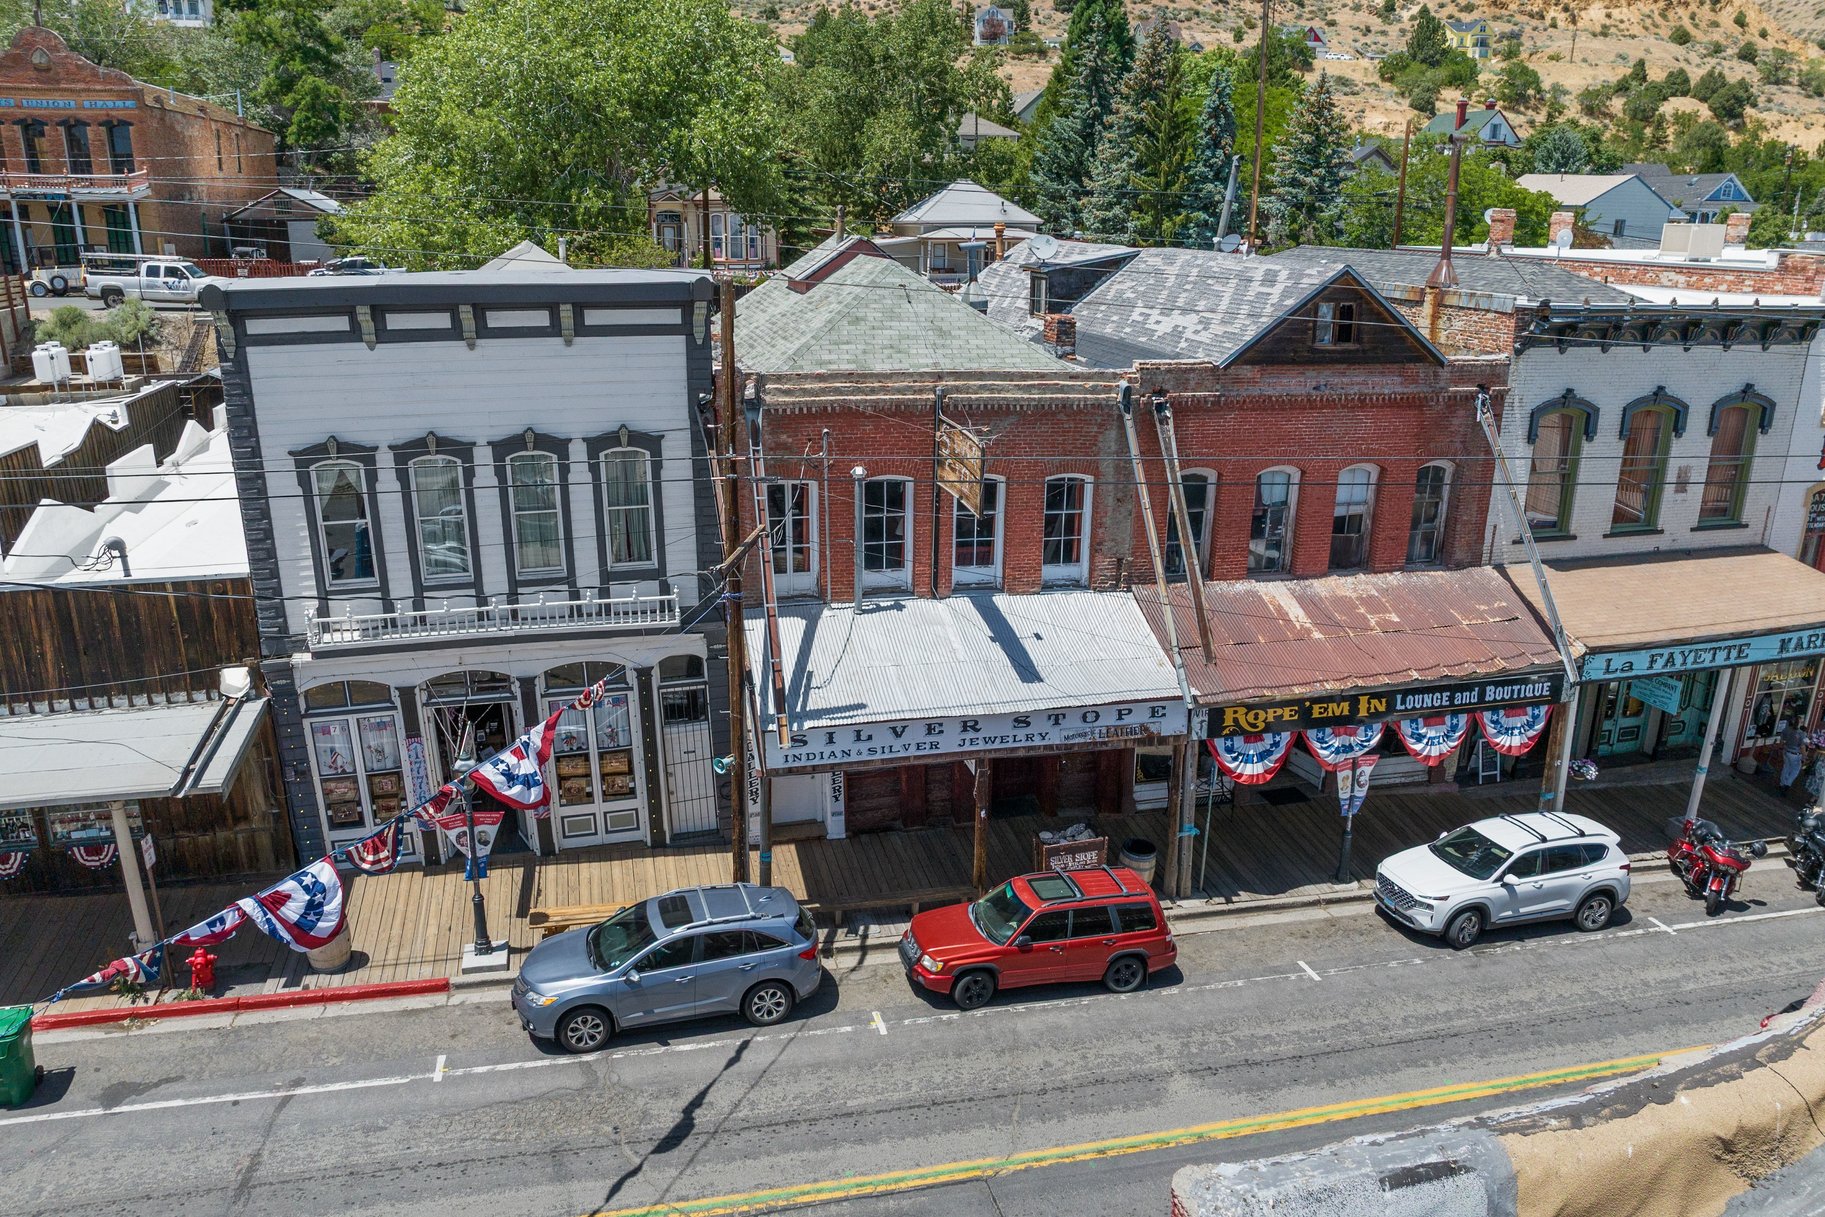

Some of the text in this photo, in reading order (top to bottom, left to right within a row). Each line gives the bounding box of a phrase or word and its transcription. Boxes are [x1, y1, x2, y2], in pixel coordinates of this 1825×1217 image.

[26, 100, 71, 108] UNION
[1603, 657, 1634, 675] La
[1646, 643, 1751, 671] FAYETTE
[1395, 682, 1551, 711] LOUNGE and BOUTIQUE
[790, 705, 1168, 748] SILVER STOPE
[1222, 695, 1387, 732] ROPE 'EM IN
[1098, 723, 1147, 739] LEATHER
[783, 748, 852, 763] INDIAN
[867, 741, 941, 756] SILVER
[412, 744, 427, 806] 1776
[1050, 853, 1073, 865] SILVER
[1075, 850, 1099, 862] STOPE
